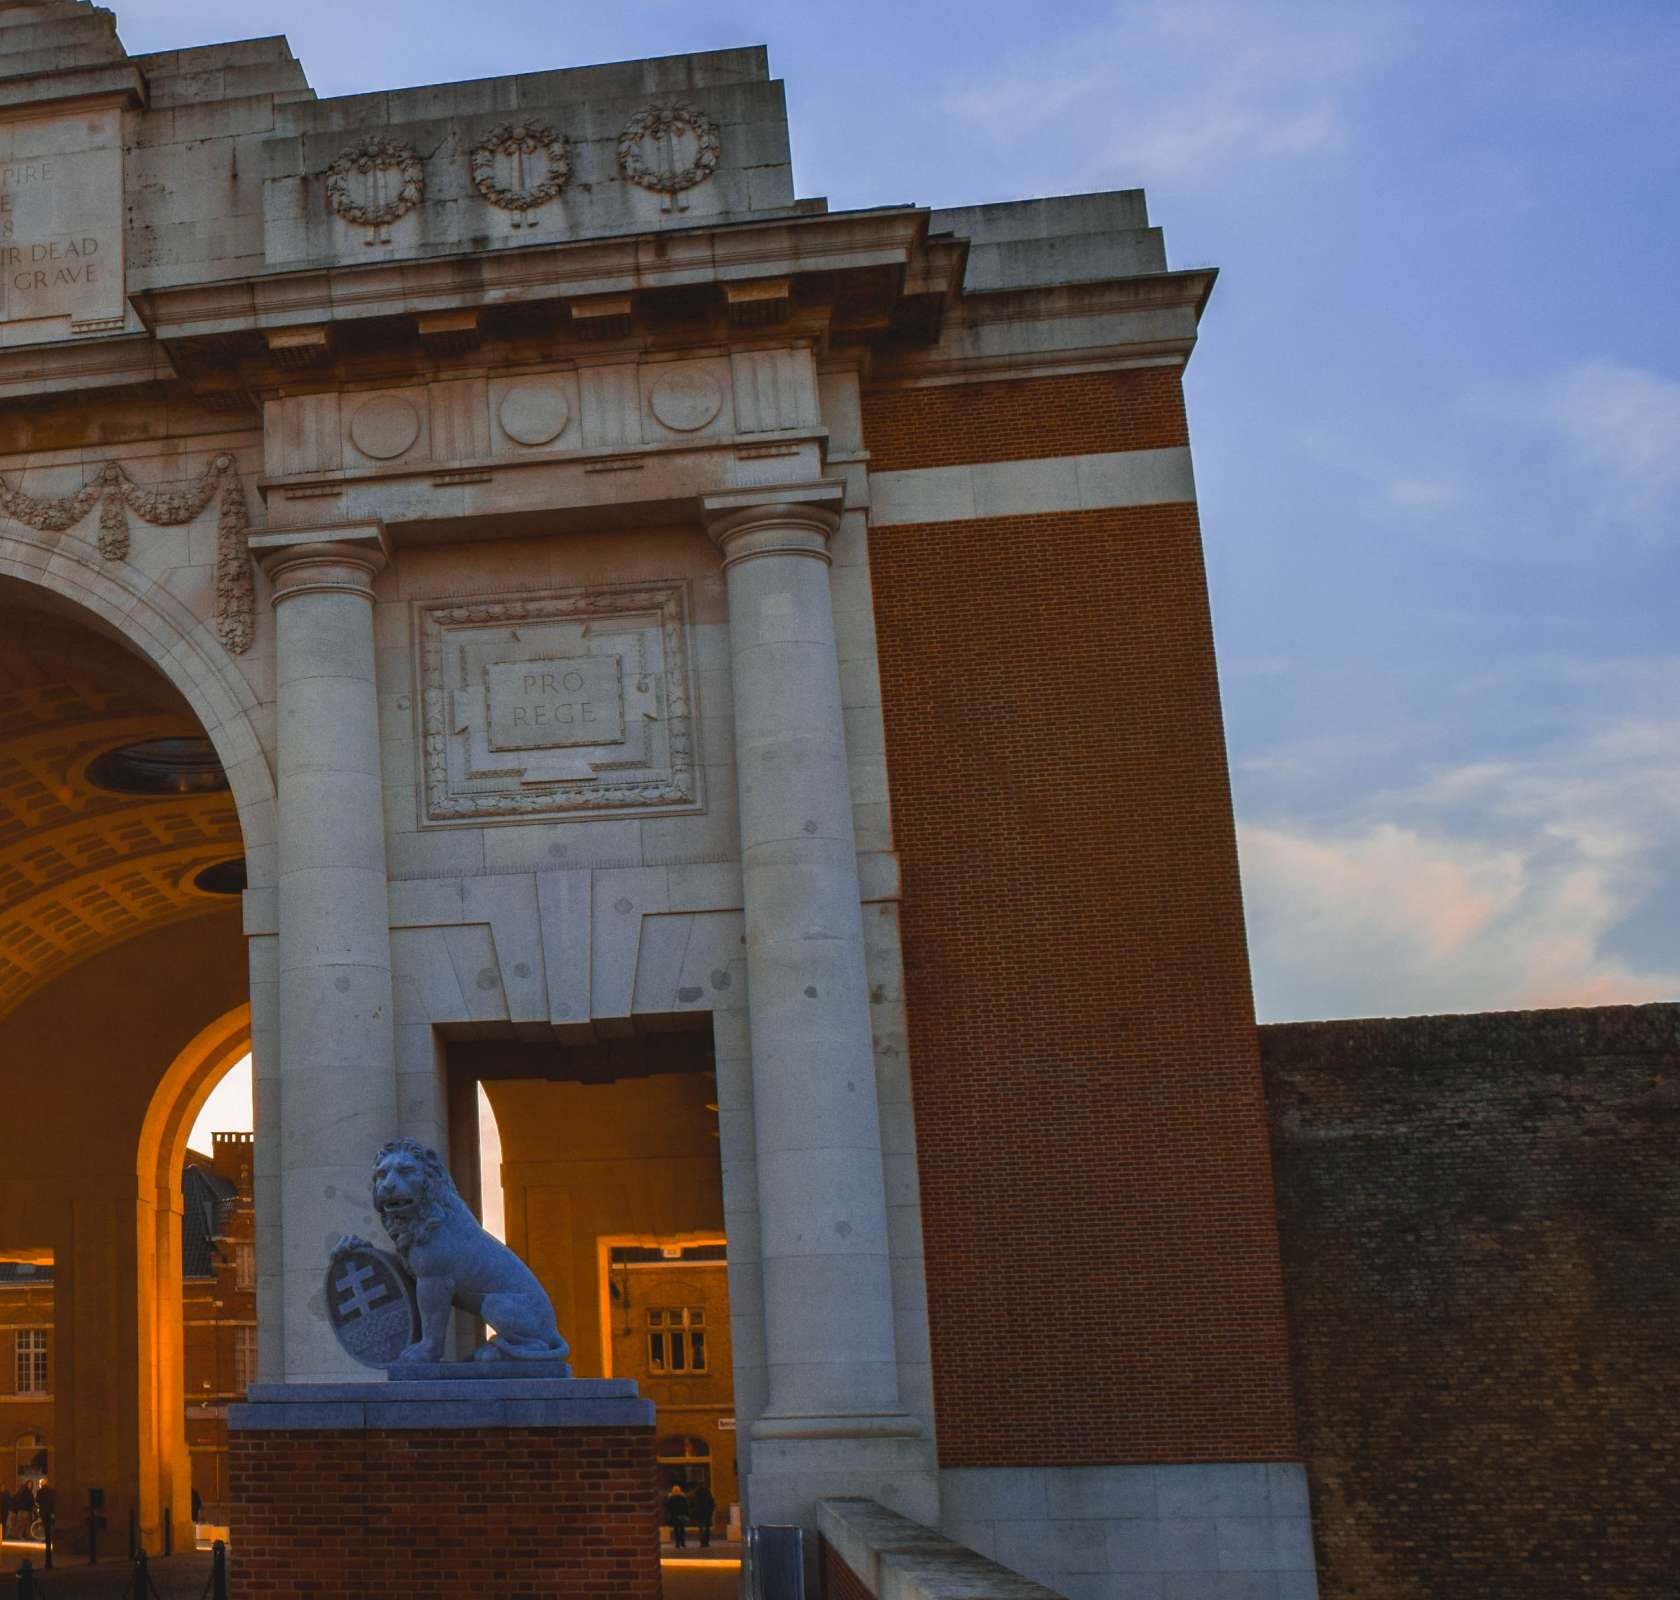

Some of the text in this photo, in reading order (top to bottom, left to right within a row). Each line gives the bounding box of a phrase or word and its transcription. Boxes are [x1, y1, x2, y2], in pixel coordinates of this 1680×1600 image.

[31, 237, 99, 263] DEAD
[13, 264, 99, 290] GRAVE
[522, 671, 584, 695] PRO
[512, 702, 597, 727] REGE
